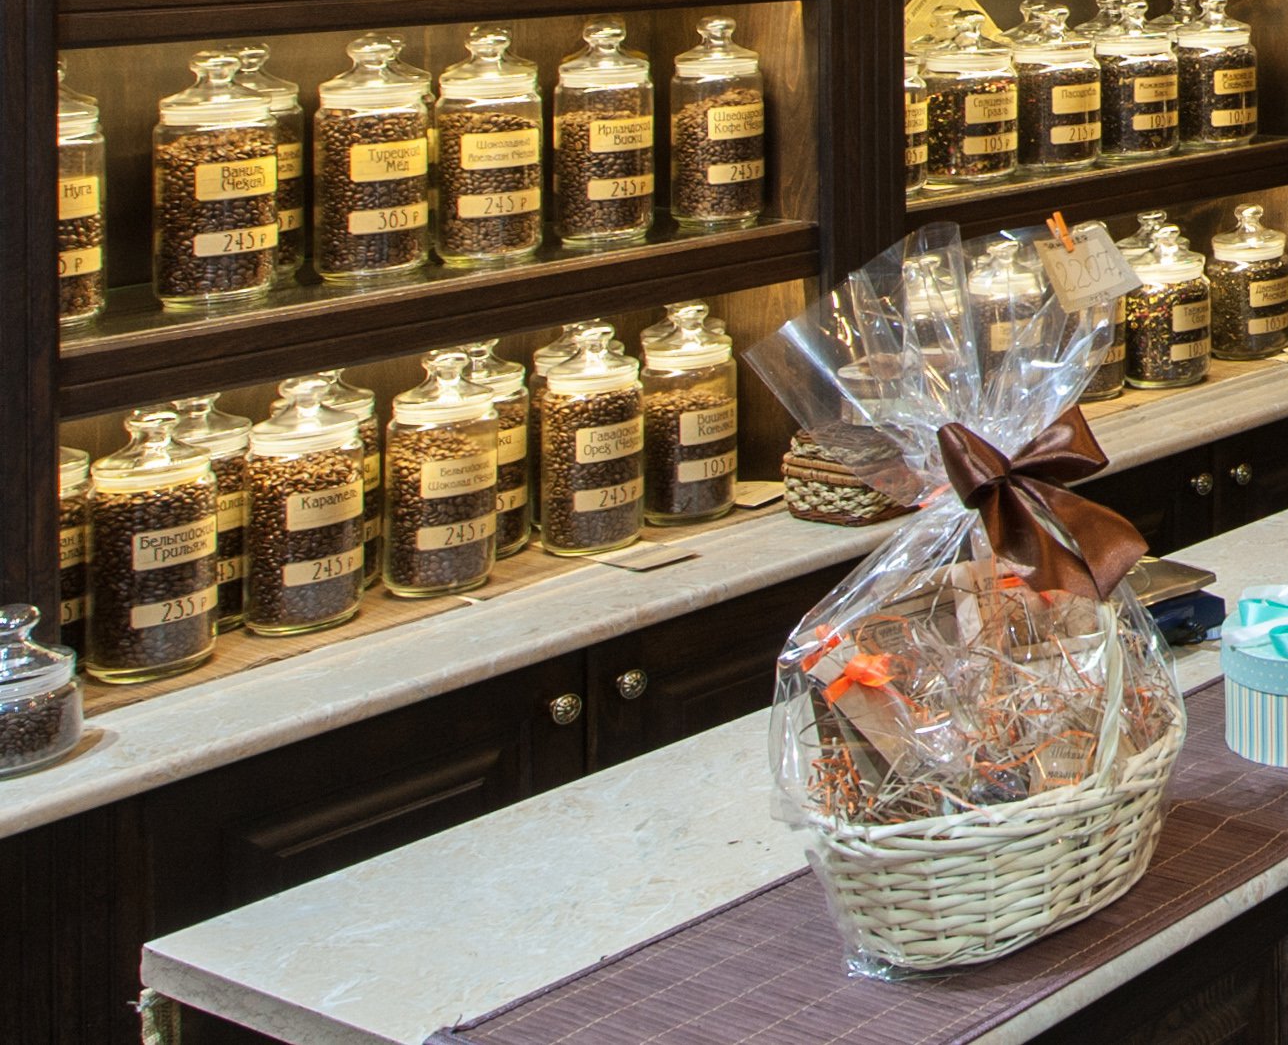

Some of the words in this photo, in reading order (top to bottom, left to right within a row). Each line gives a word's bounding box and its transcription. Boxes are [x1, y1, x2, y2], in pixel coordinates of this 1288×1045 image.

[221, 164, 265, 180] Ваниль
[63, 182, 93, 200] Нуга
[583, 439, 612, 456] Орех
[300, 489, 358, 511] Карамель
[160, 599, 196, 623] 235
